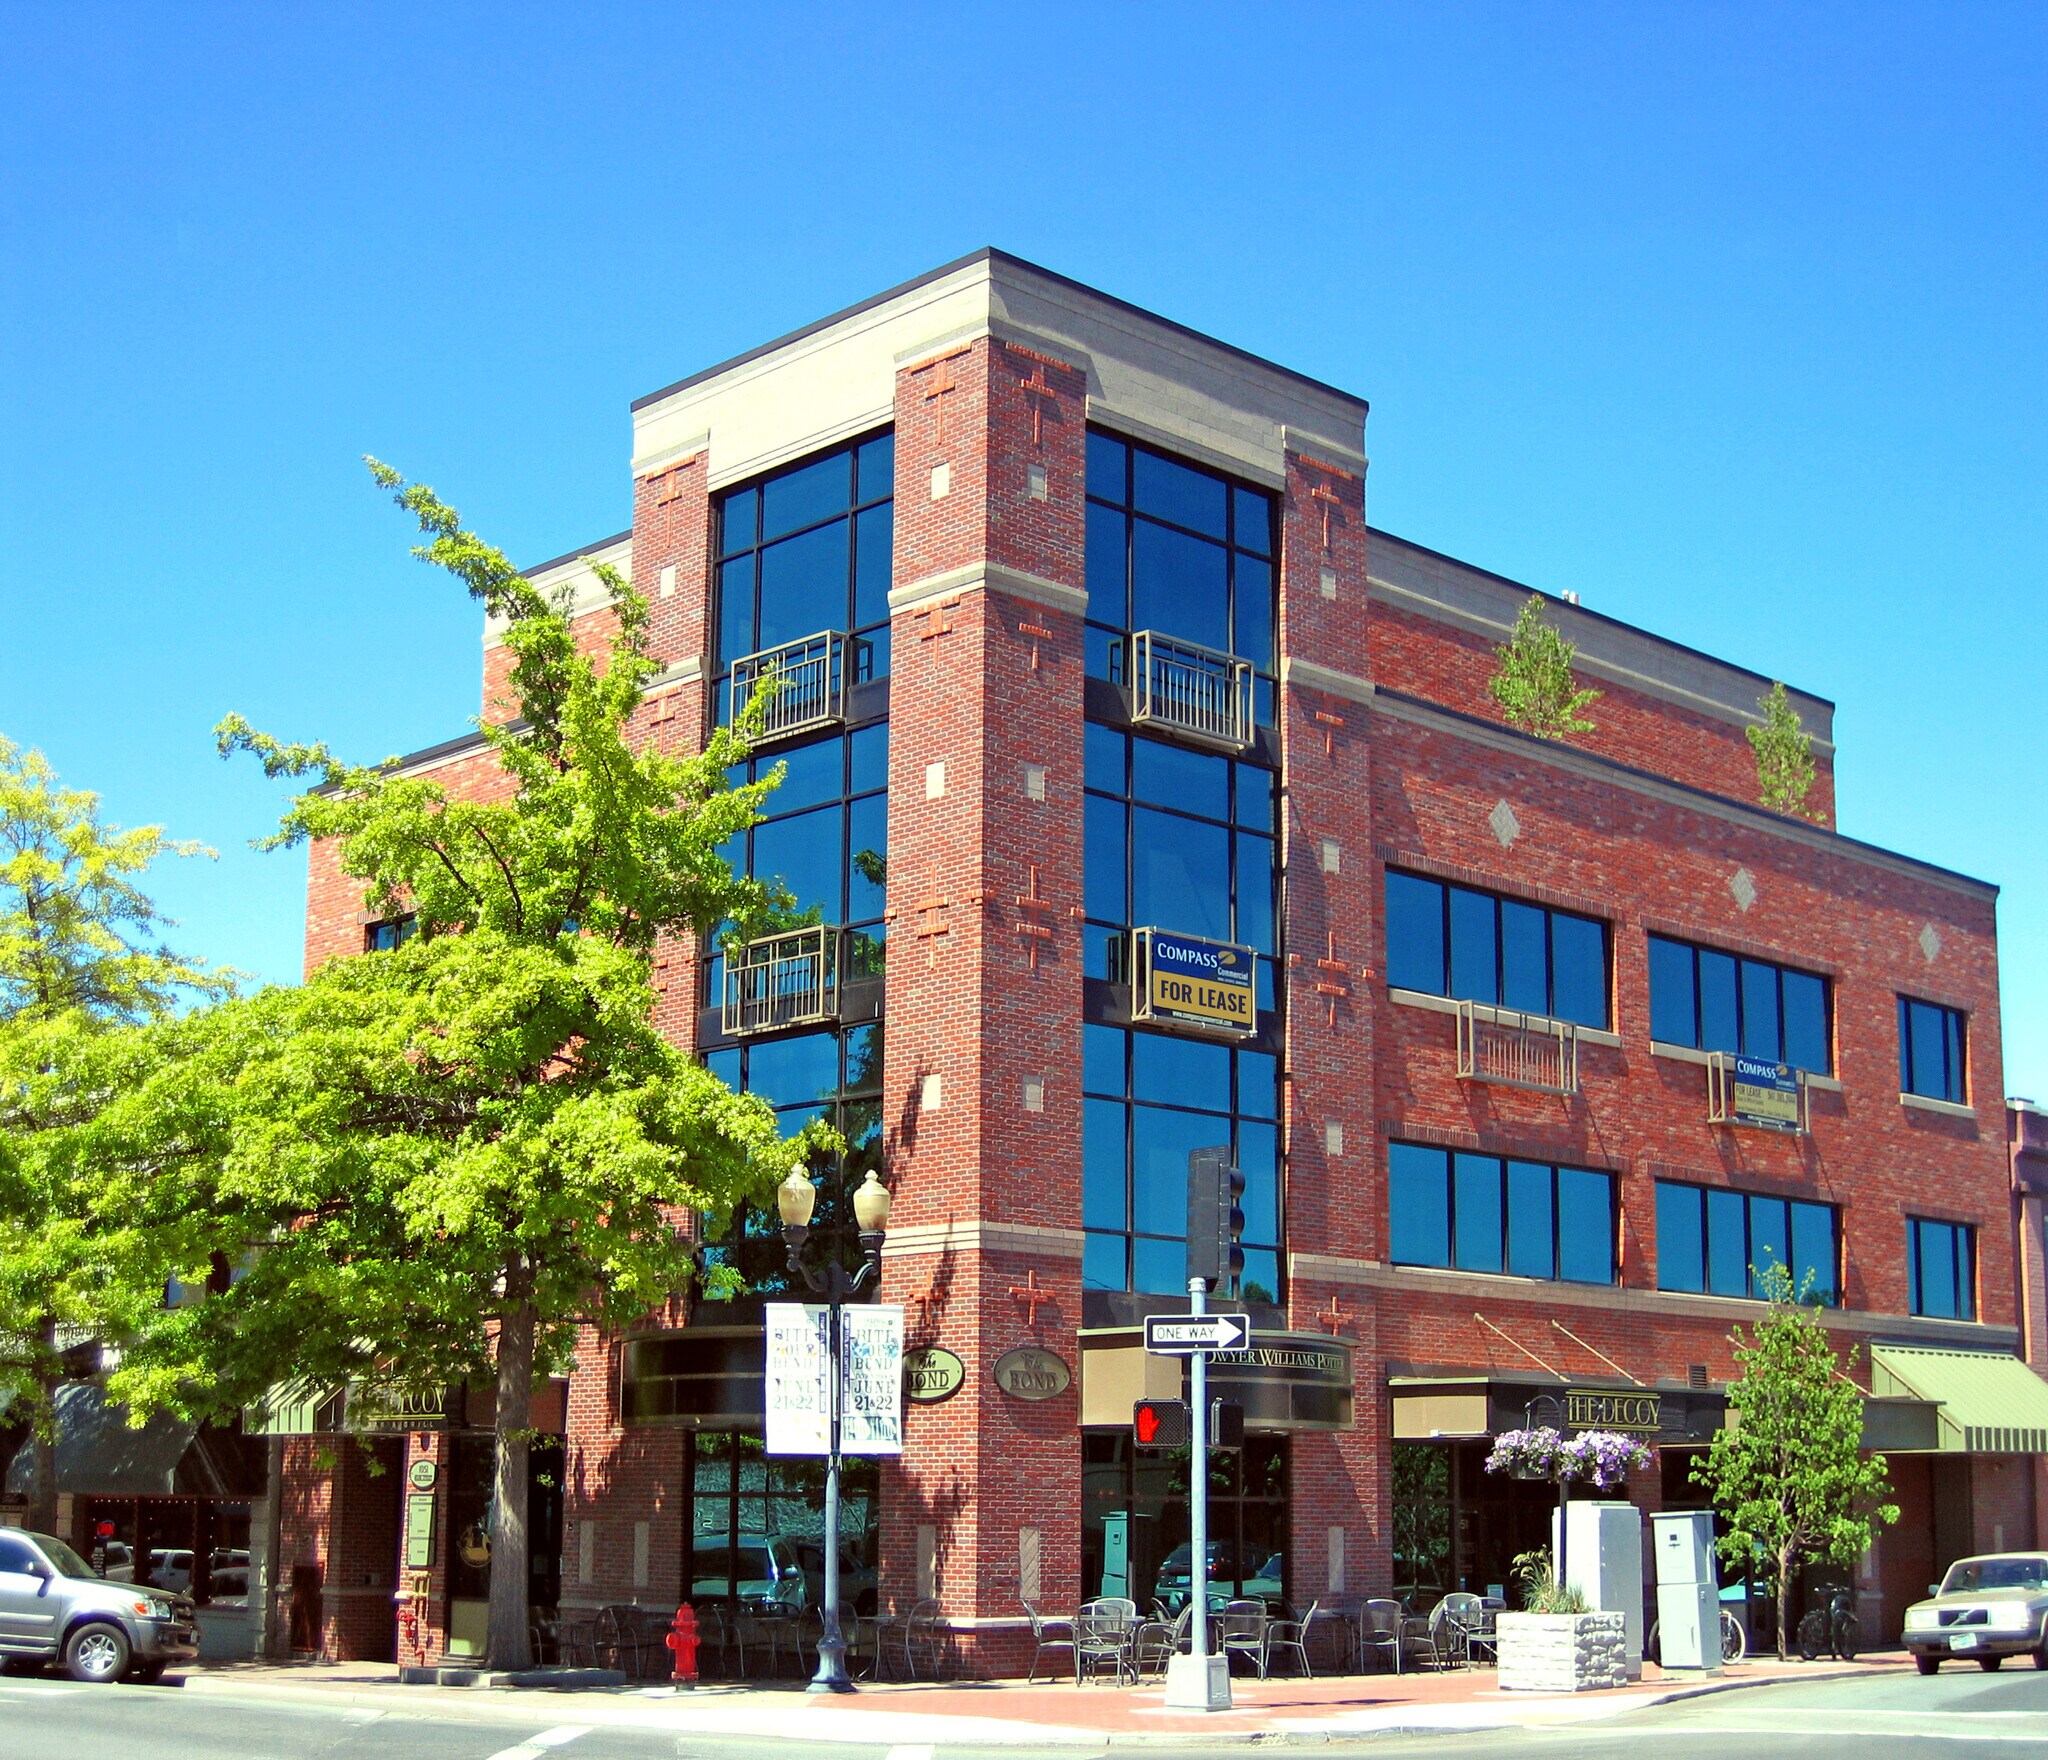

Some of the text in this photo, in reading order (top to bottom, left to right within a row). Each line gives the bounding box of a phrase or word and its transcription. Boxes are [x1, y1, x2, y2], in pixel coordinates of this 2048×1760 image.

[1157, 942, 1218, 969] COMPASS
[1160, 979, 1247, 1015] FOR LEASE
[1737, 1060, 1776, 1079] COMPASS
[1156, 1326, 1216, 1340] ONE WAY
[773, 1357, 813, 1369] BEND
[855, 1357, 893, 1370] BEND
[919, 1352, 936, 1370] The
[1258, 1348, 1315, 1367] WILLIAMS
[854, 1380, 894, 1394] JUNE
[906, 1371, 949, 1388] BOND
[1010, 1371, 1056, 1390] BOND
[1567, 1396, 1662, 1425] THE DECOY
